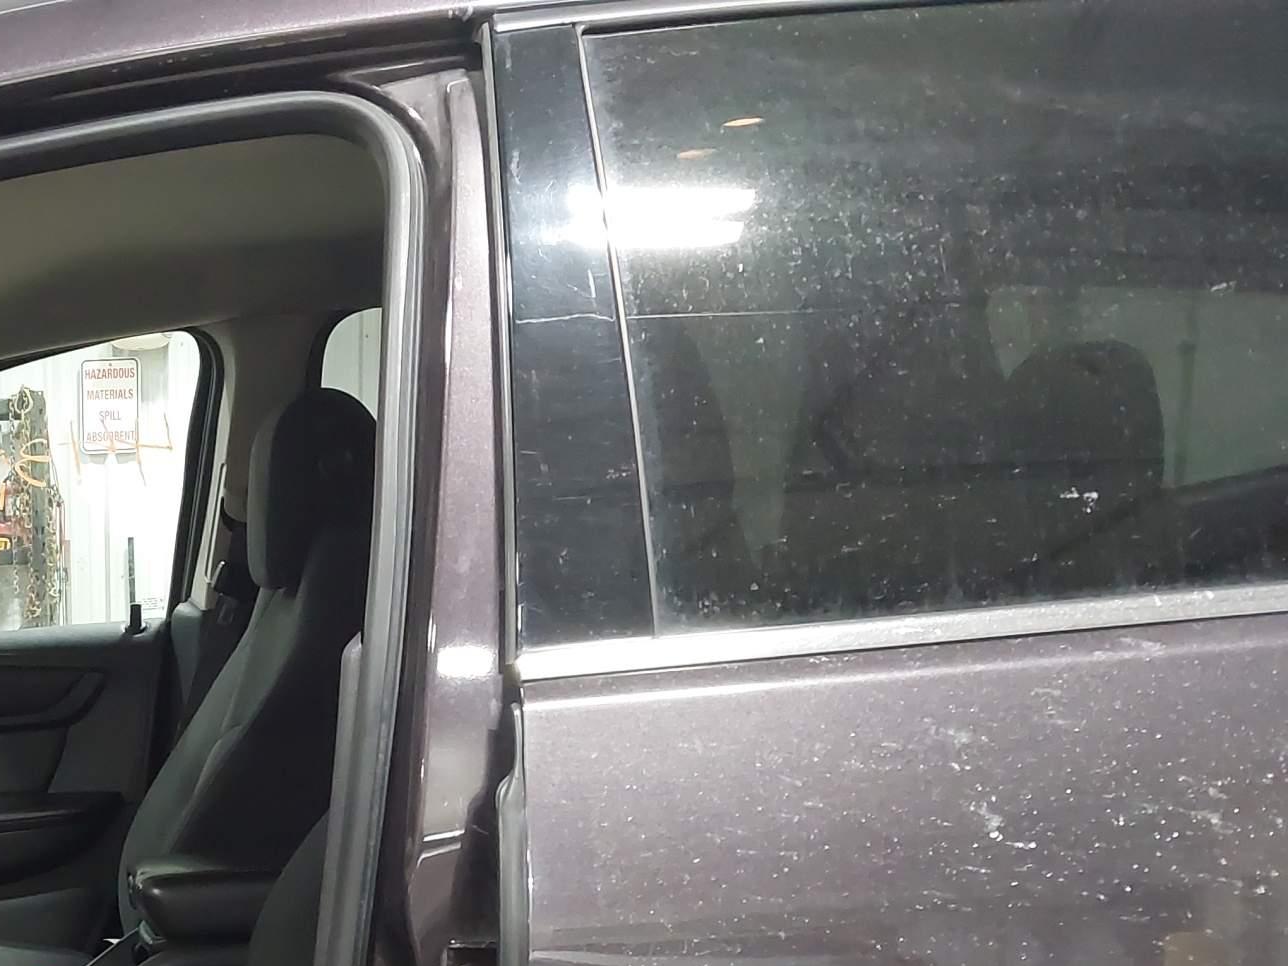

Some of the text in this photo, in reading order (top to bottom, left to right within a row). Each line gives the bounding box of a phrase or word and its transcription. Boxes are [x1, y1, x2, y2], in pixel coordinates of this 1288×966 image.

[84, 367, 135, 380] HAZARDOUS
[87, 389, 134, 401] MATERIALS
[99, 410, 122, 421] SPILL
[87, 431, 135, 442] ABSORBENT
